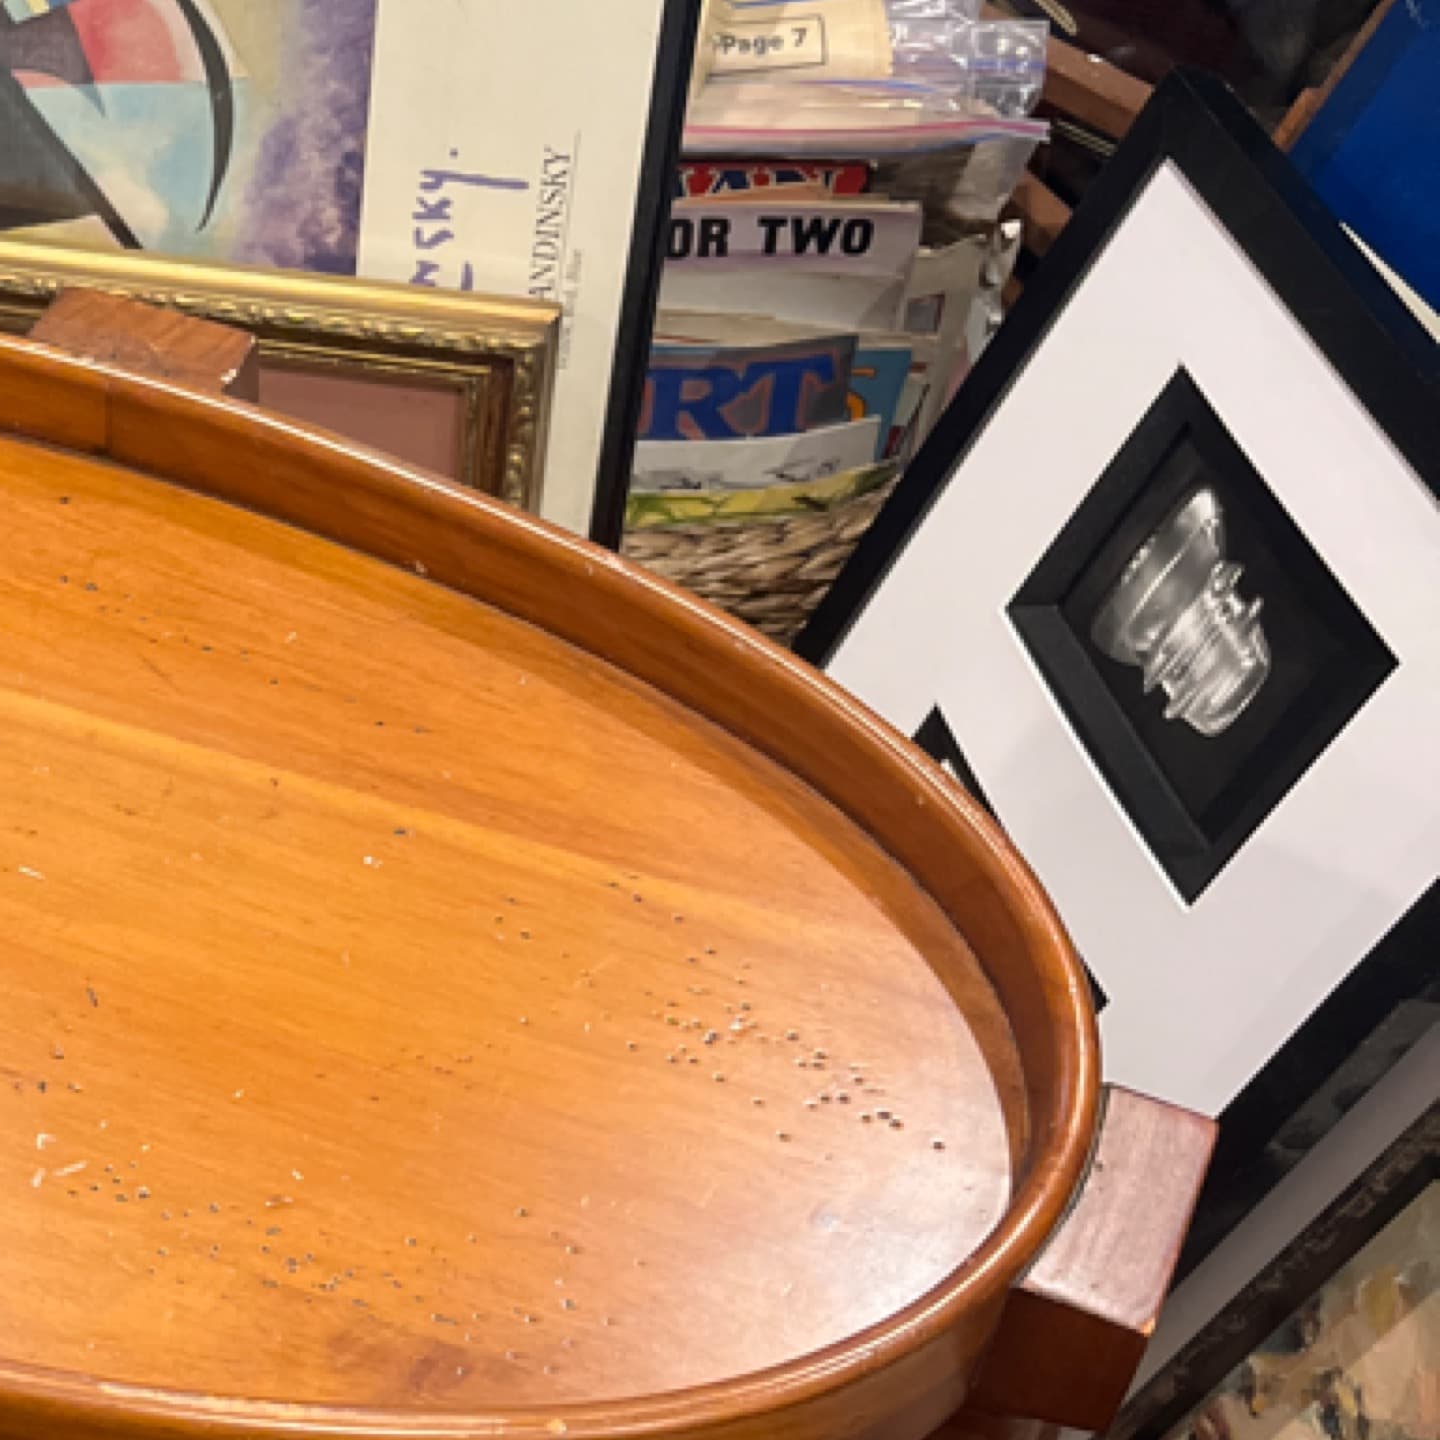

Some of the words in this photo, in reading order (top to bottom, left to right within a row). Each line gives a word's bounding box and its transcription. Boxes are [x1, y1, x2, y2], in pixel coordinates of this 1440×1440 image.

[791, 27, 808, 47] 7
[528, 143, 571, 300] ANDINSKY
[758, 216, 875, 255] TWO
[646, 352, 835, 441] RT
